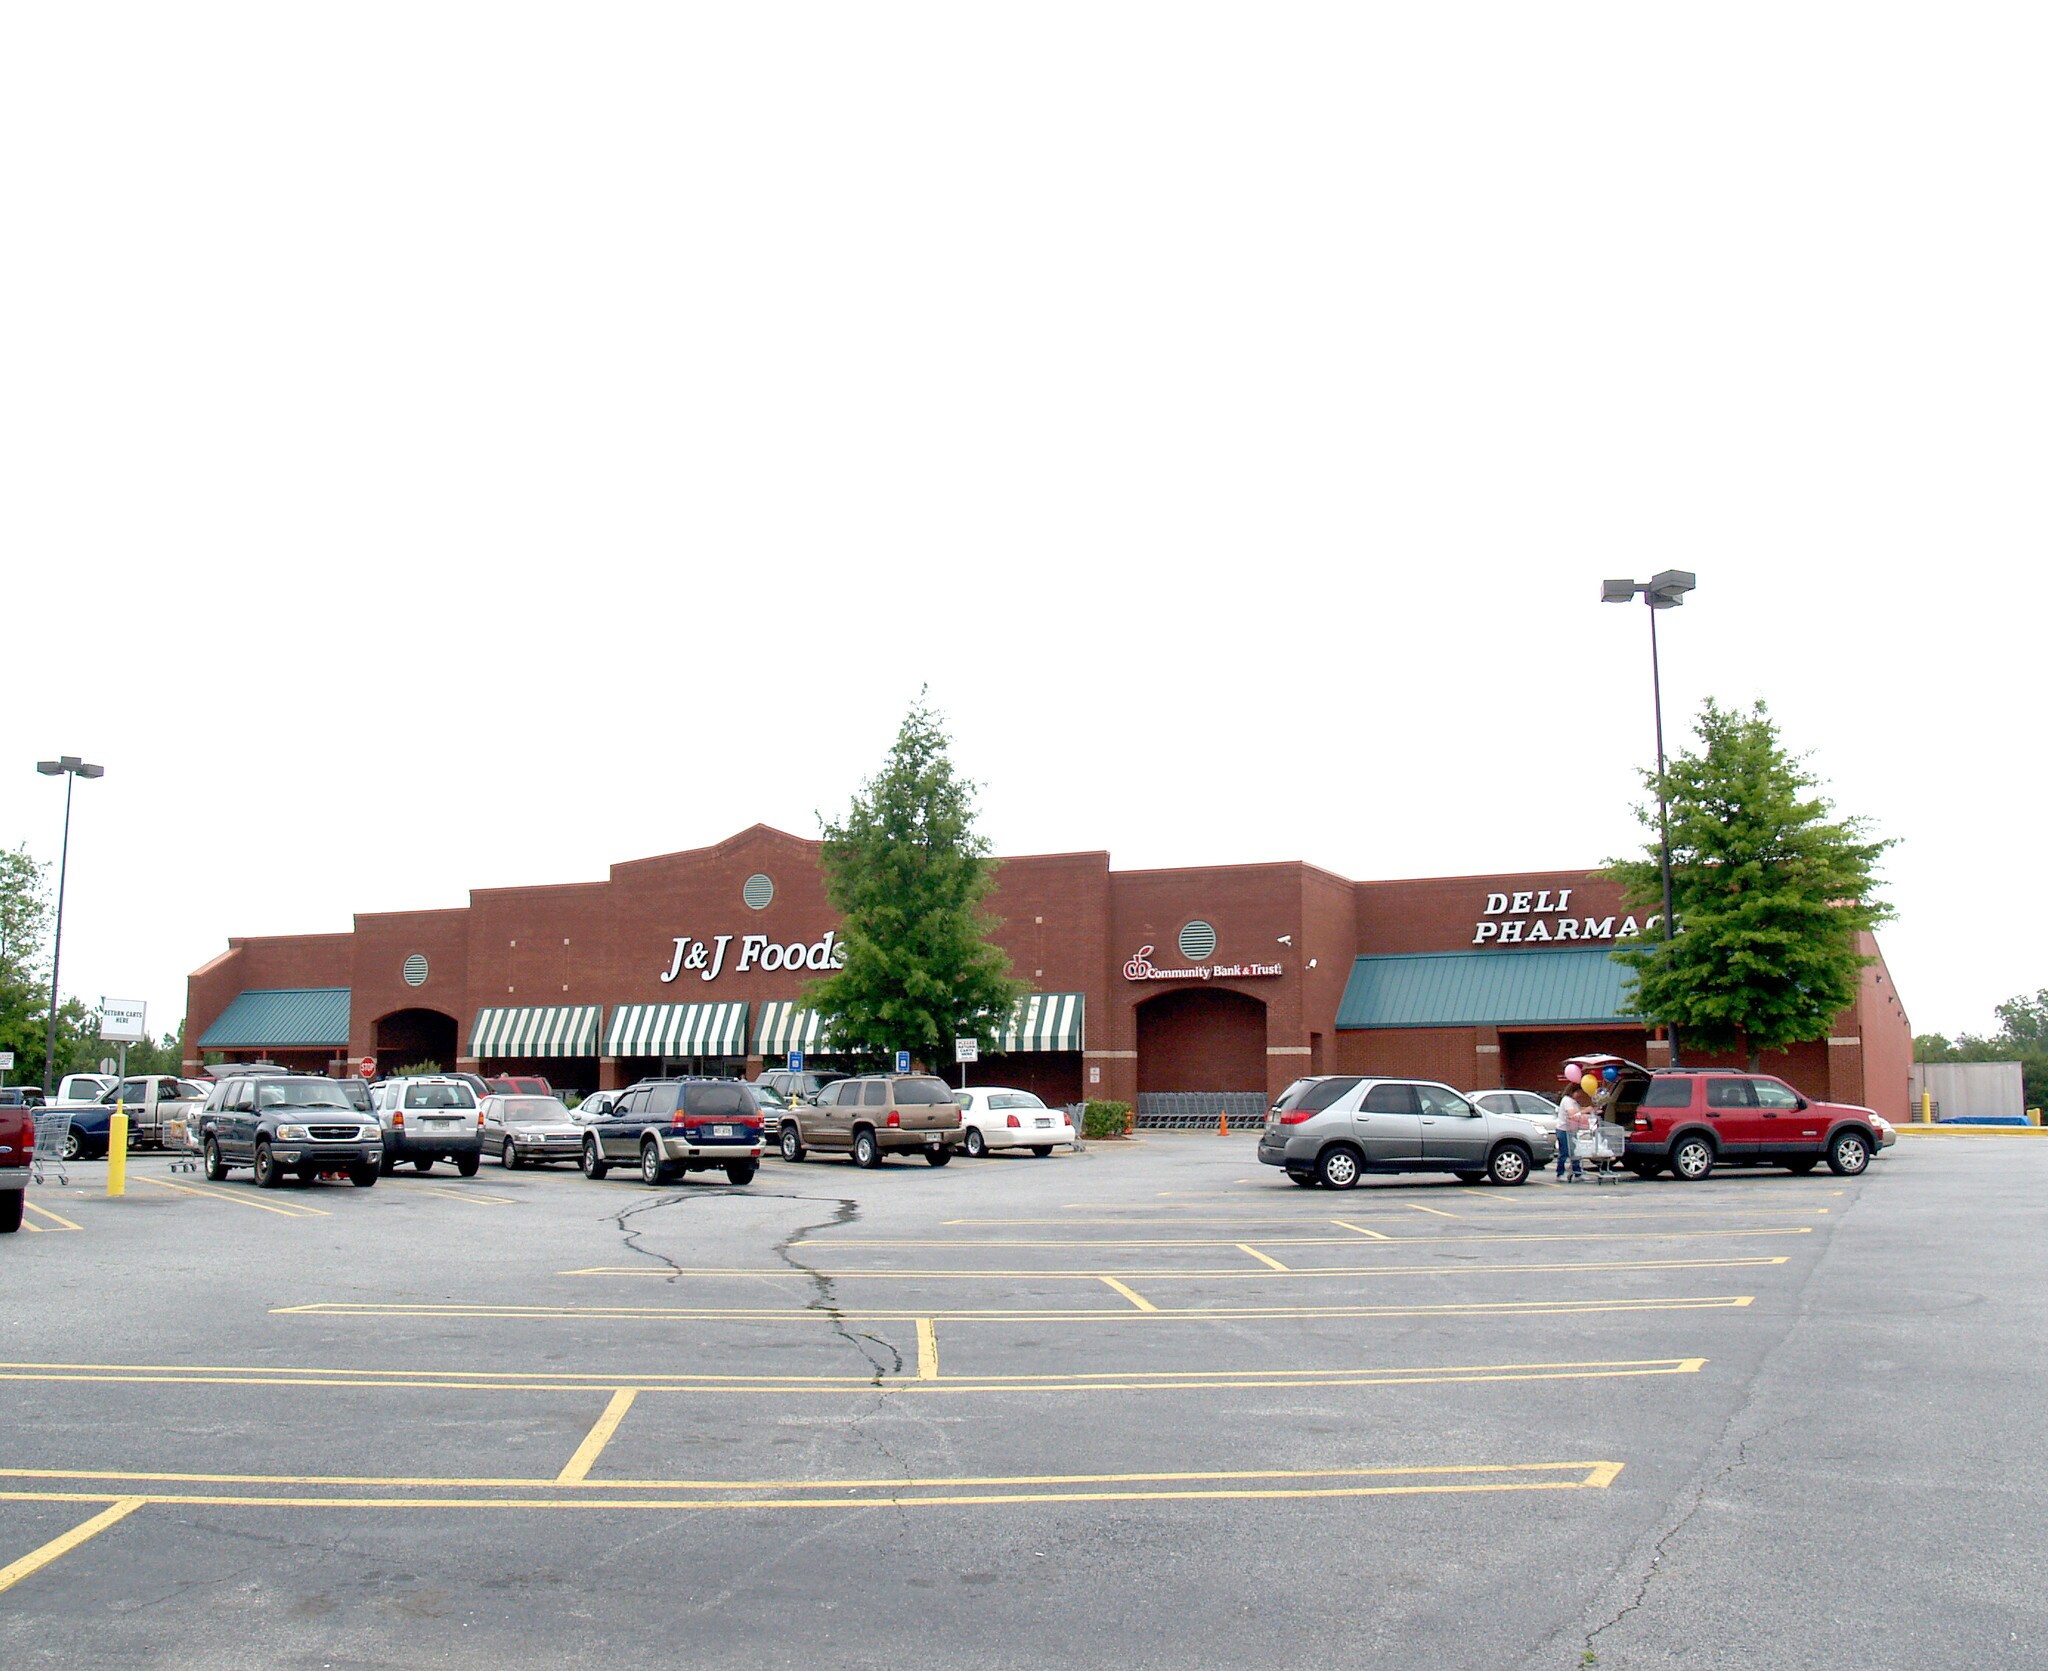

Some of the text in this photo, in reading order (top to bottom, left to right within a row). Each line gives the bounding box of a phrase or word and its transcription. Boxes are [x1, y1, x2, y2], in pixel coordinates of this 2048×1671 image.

[1483, 889, 1572, 915] DELI
[660, 931, 848, 983] J&J Foods
[1147, 965, 1211, 980] Community
[1213, 965, 1241, 976] Bank
[1242, 966, 1250, 976] &
[361, 1063, 374, 1071] STOP
